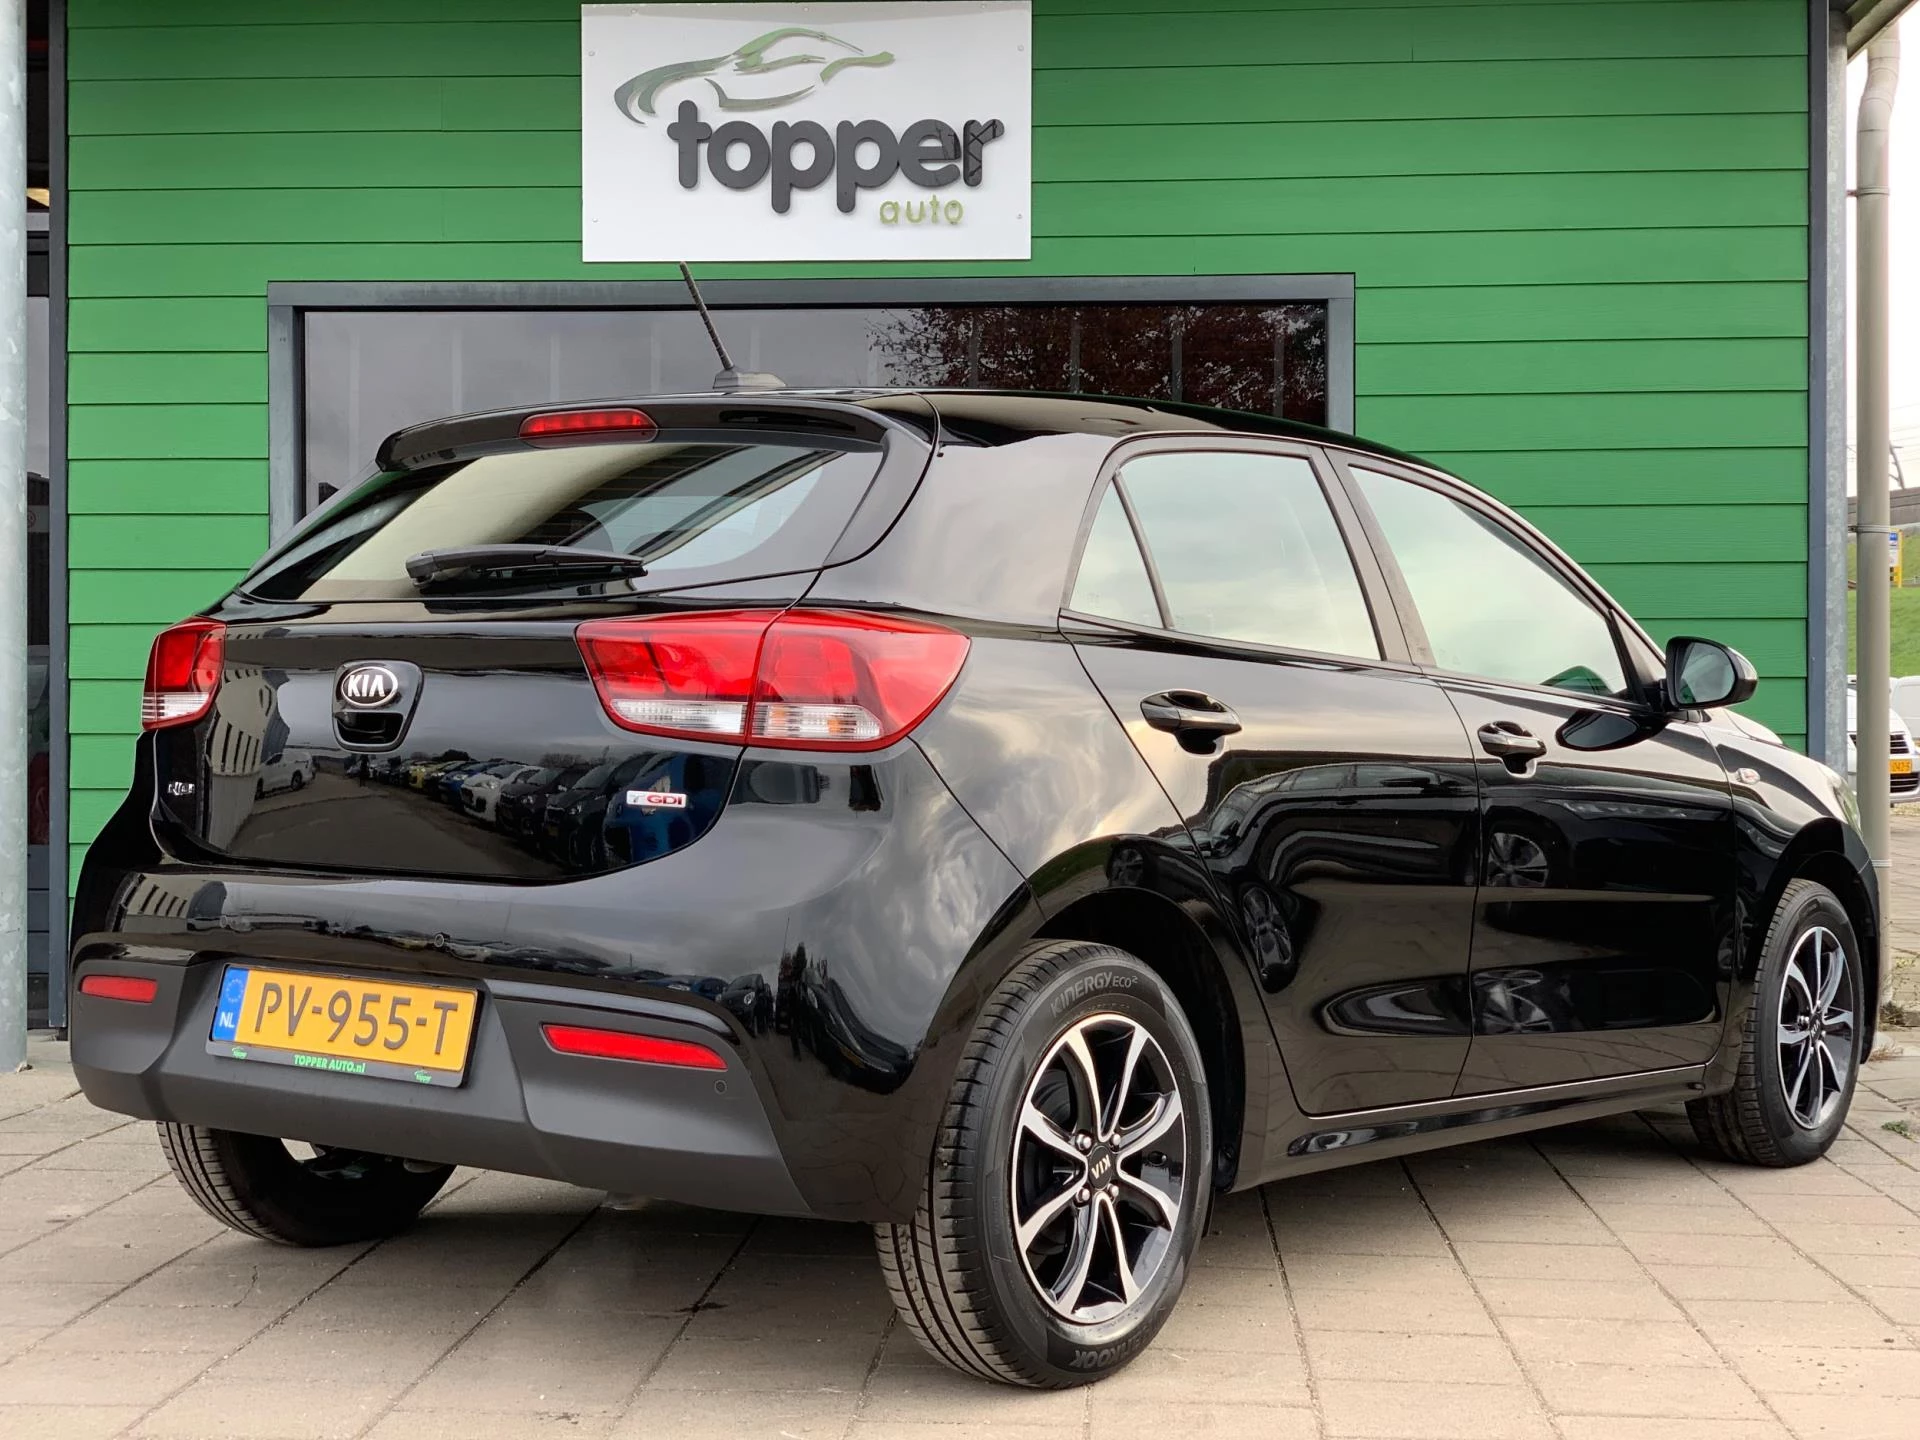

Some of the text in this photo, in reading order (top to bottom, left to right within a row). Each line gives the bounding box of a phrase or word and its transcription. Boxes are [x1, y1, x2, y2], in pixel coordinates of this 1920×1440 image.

[667, 99, 1005, 214] topper
[879, 194, 964, 225] auto
[347, 674, 386, 697] KIA
[219, 1012, 235, 1029] NL
[254, 982, 459, 1055] PV-955-T
[294, 1054, 366, 1073] TOPPER AUTO.nl
[1091, 1154, 1111, 1180] KIA
